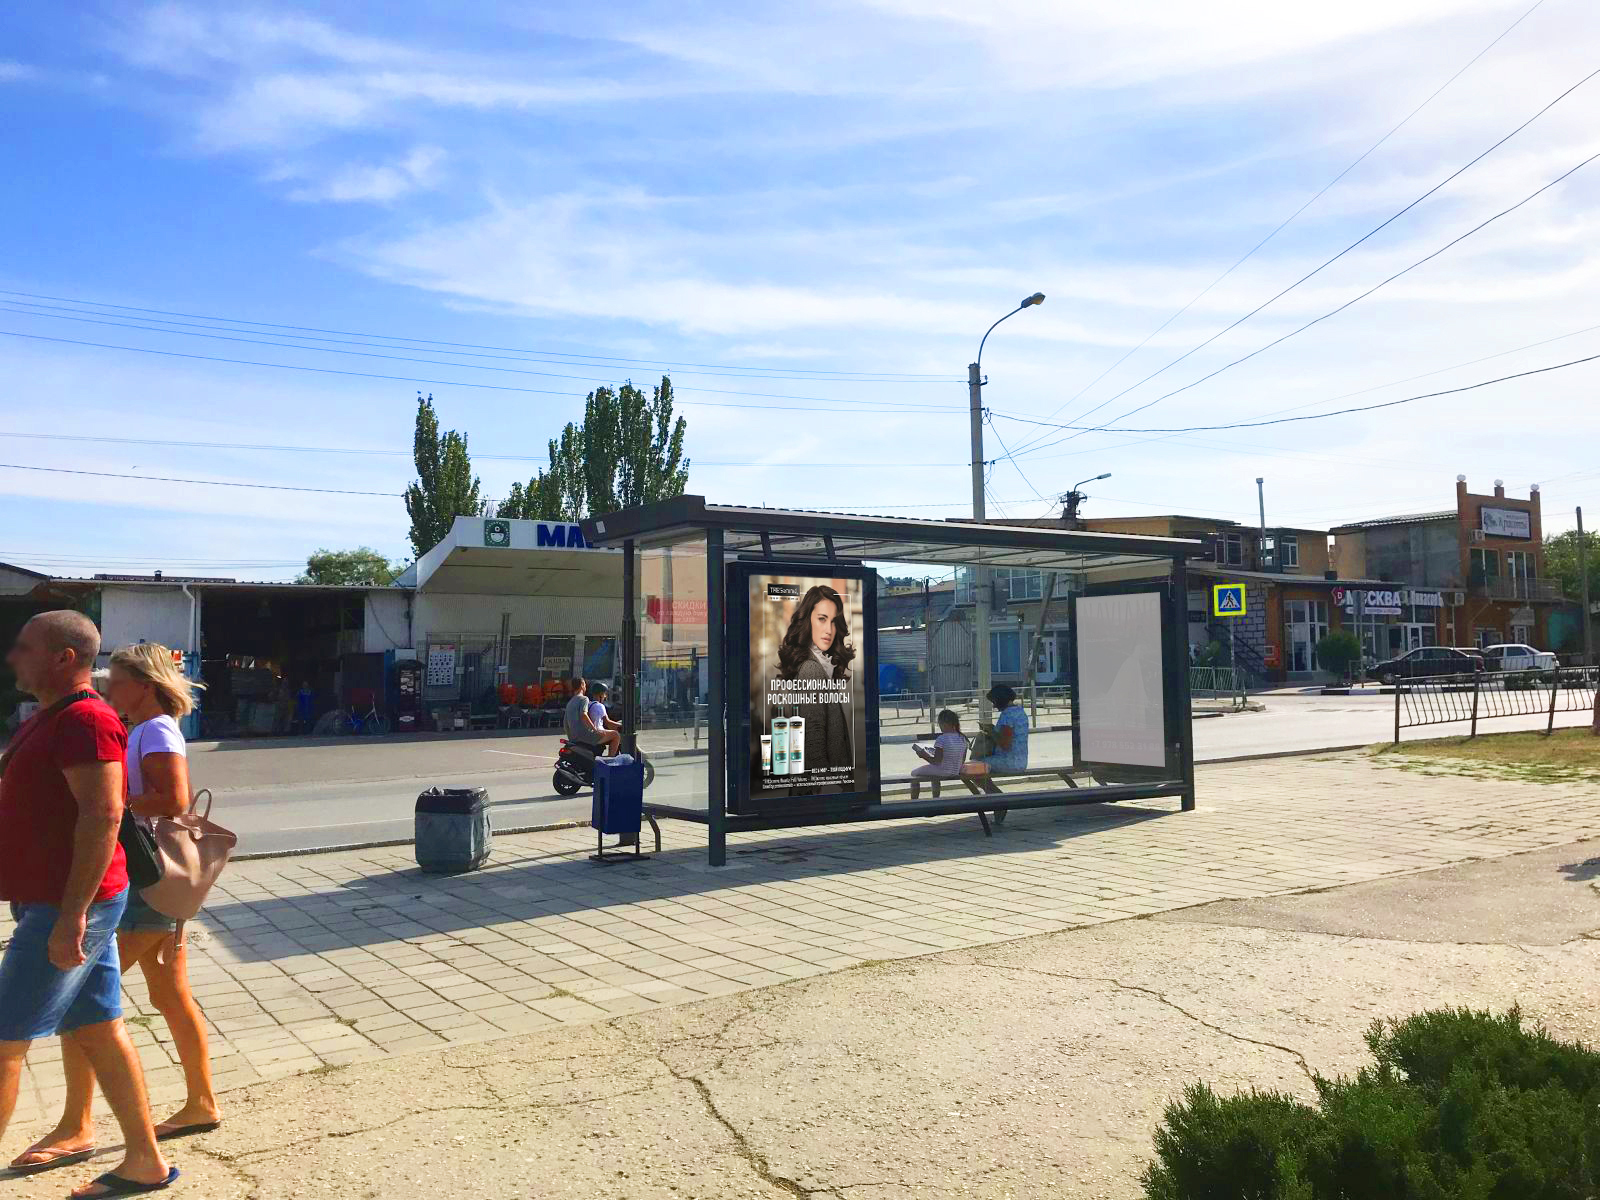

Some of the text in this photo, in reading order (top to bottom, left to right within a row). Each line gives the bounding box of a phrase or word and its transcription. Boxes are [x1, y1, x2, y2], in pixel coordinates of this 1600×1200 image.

[537, 524, 593, 548] МА
[770, 679, 847, 691] ПРОФЕССИОНАЛЬНО
[767, 692, 850, 705] РОСКОШНЫЕ ВОЛОСЫ
